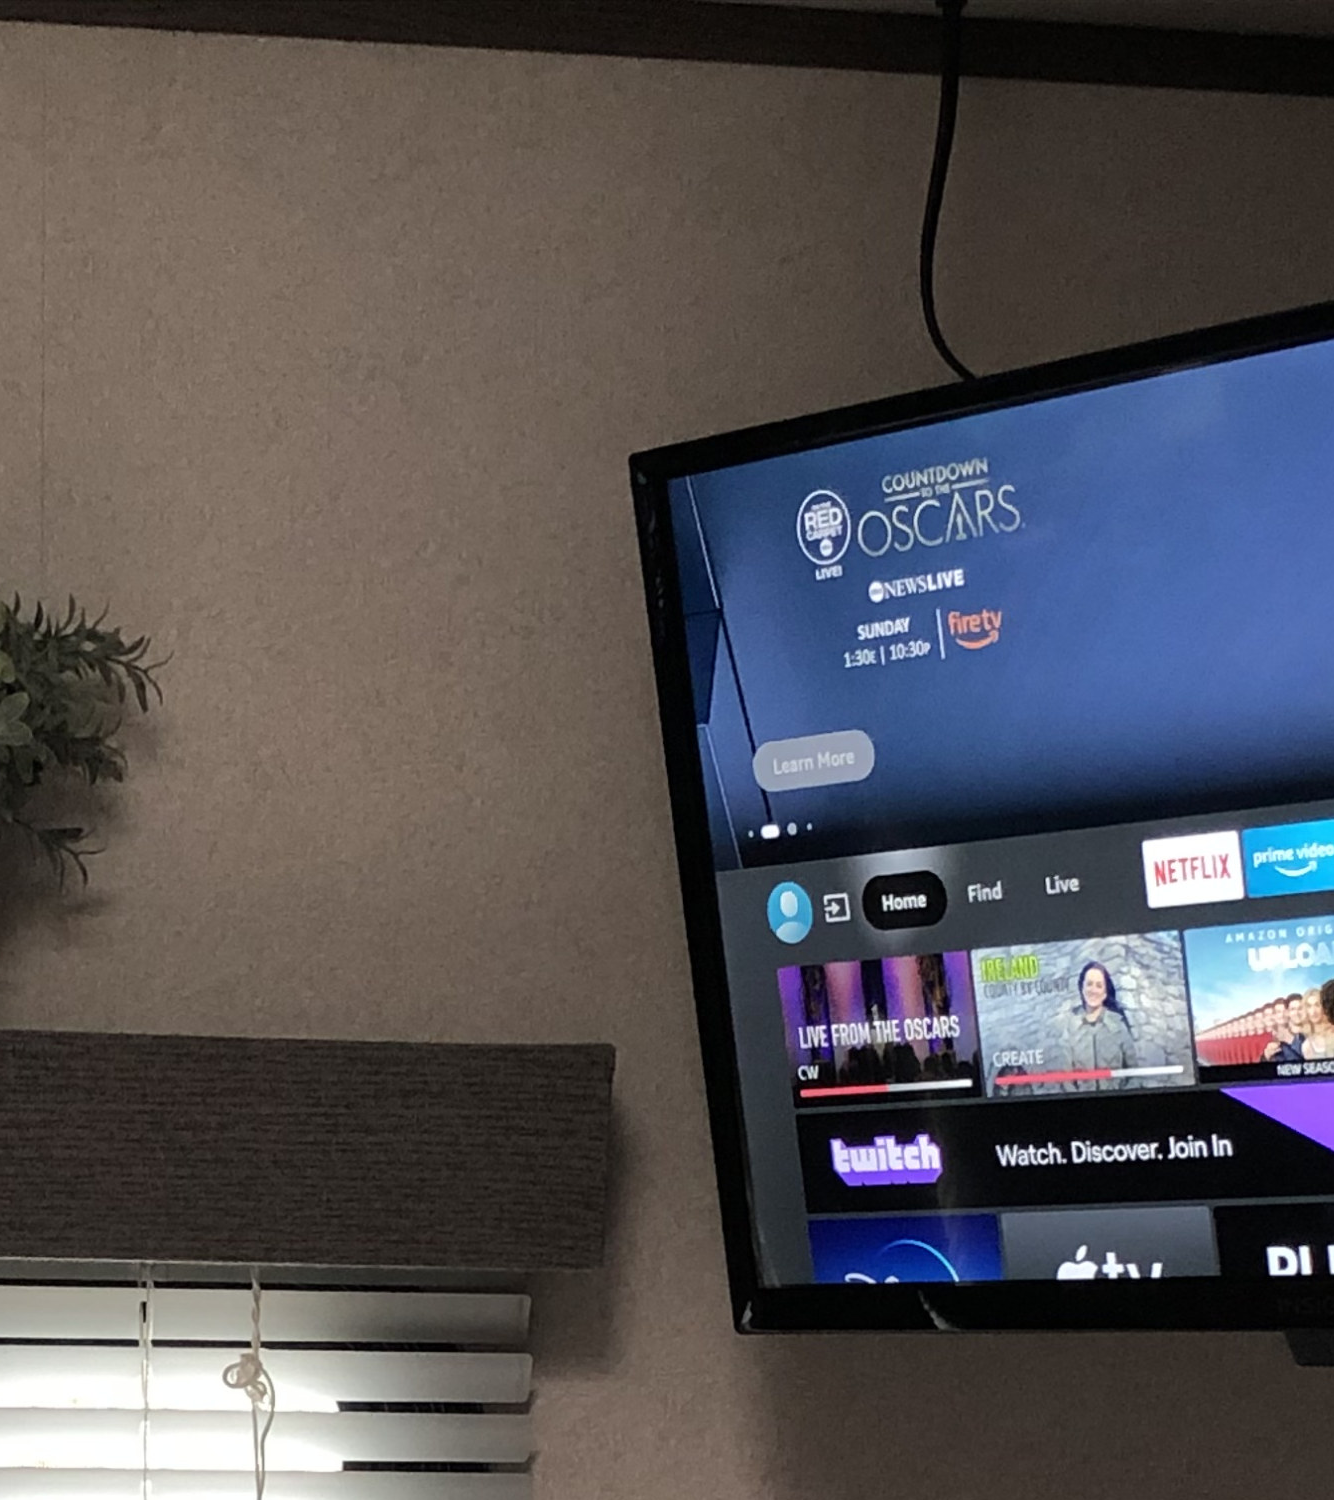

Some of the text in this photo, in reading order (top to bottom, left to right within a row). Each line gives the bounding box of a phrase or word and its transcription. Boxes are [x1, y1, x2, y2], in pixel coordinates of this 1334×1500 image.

[881, 457, 989, 494] COUNTDOWN
[803, 507, 843, 531] RED
[857, 484, 1021, 558] OSCARS
[857, 616, 911, 640] SUNDAY
[772, 750, 855, 775] Learn More
[1253, 846, 1294, 868] prime
[1154, 854, 1232, 887] NETFLIX
[967, 880, 1003, 903] Find
[1044, 874, 1080, 895] Live
[881, 893, 928, 912] Home
[1224, 928, 1288, 944] AMAZON
[980, 955, 1039, 982] IRELAND
[797, 1015, 961, 1050] LIVE FROM THE OSCARS
[992, 1048, 1045, 1068] CREATE
[1276, 1063, 1302, 1076] NEW
[797, 1065, 820, 1081] CW
[829, 1134, 943, 1179] twitch
[995, 1133, 1234, 1168] Watch. Discover. Join In
